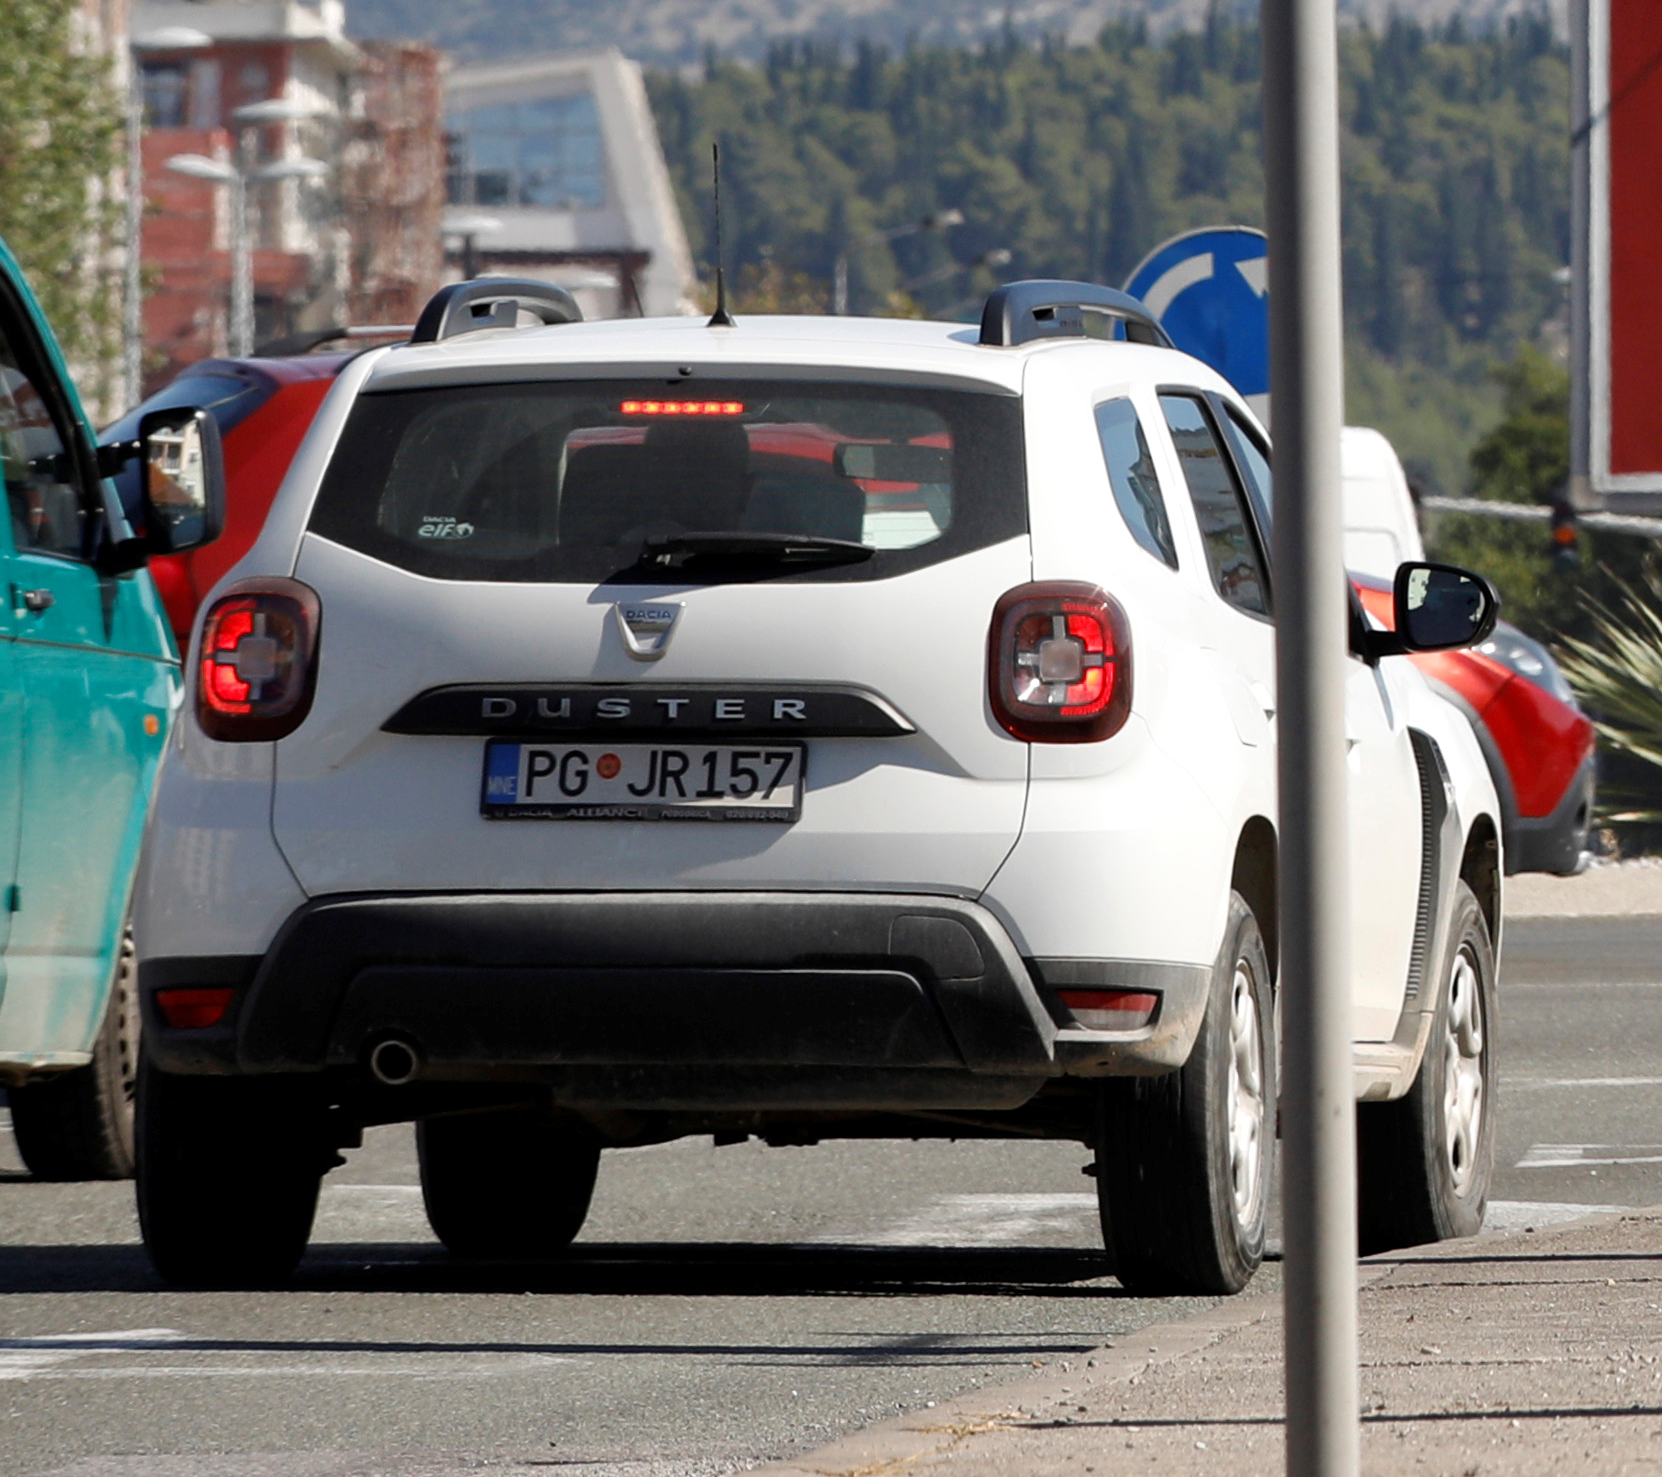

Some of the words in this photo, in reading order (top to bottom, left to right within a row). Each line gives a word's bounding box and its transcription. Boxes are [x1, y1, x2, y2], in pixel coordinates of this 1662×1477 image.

[626, 609, 672, 620] DACIA
[482, 697, 807, 720] DUSTER
[525, 749, 590, 798] PG
[627, 749, 794, 801] JR157
